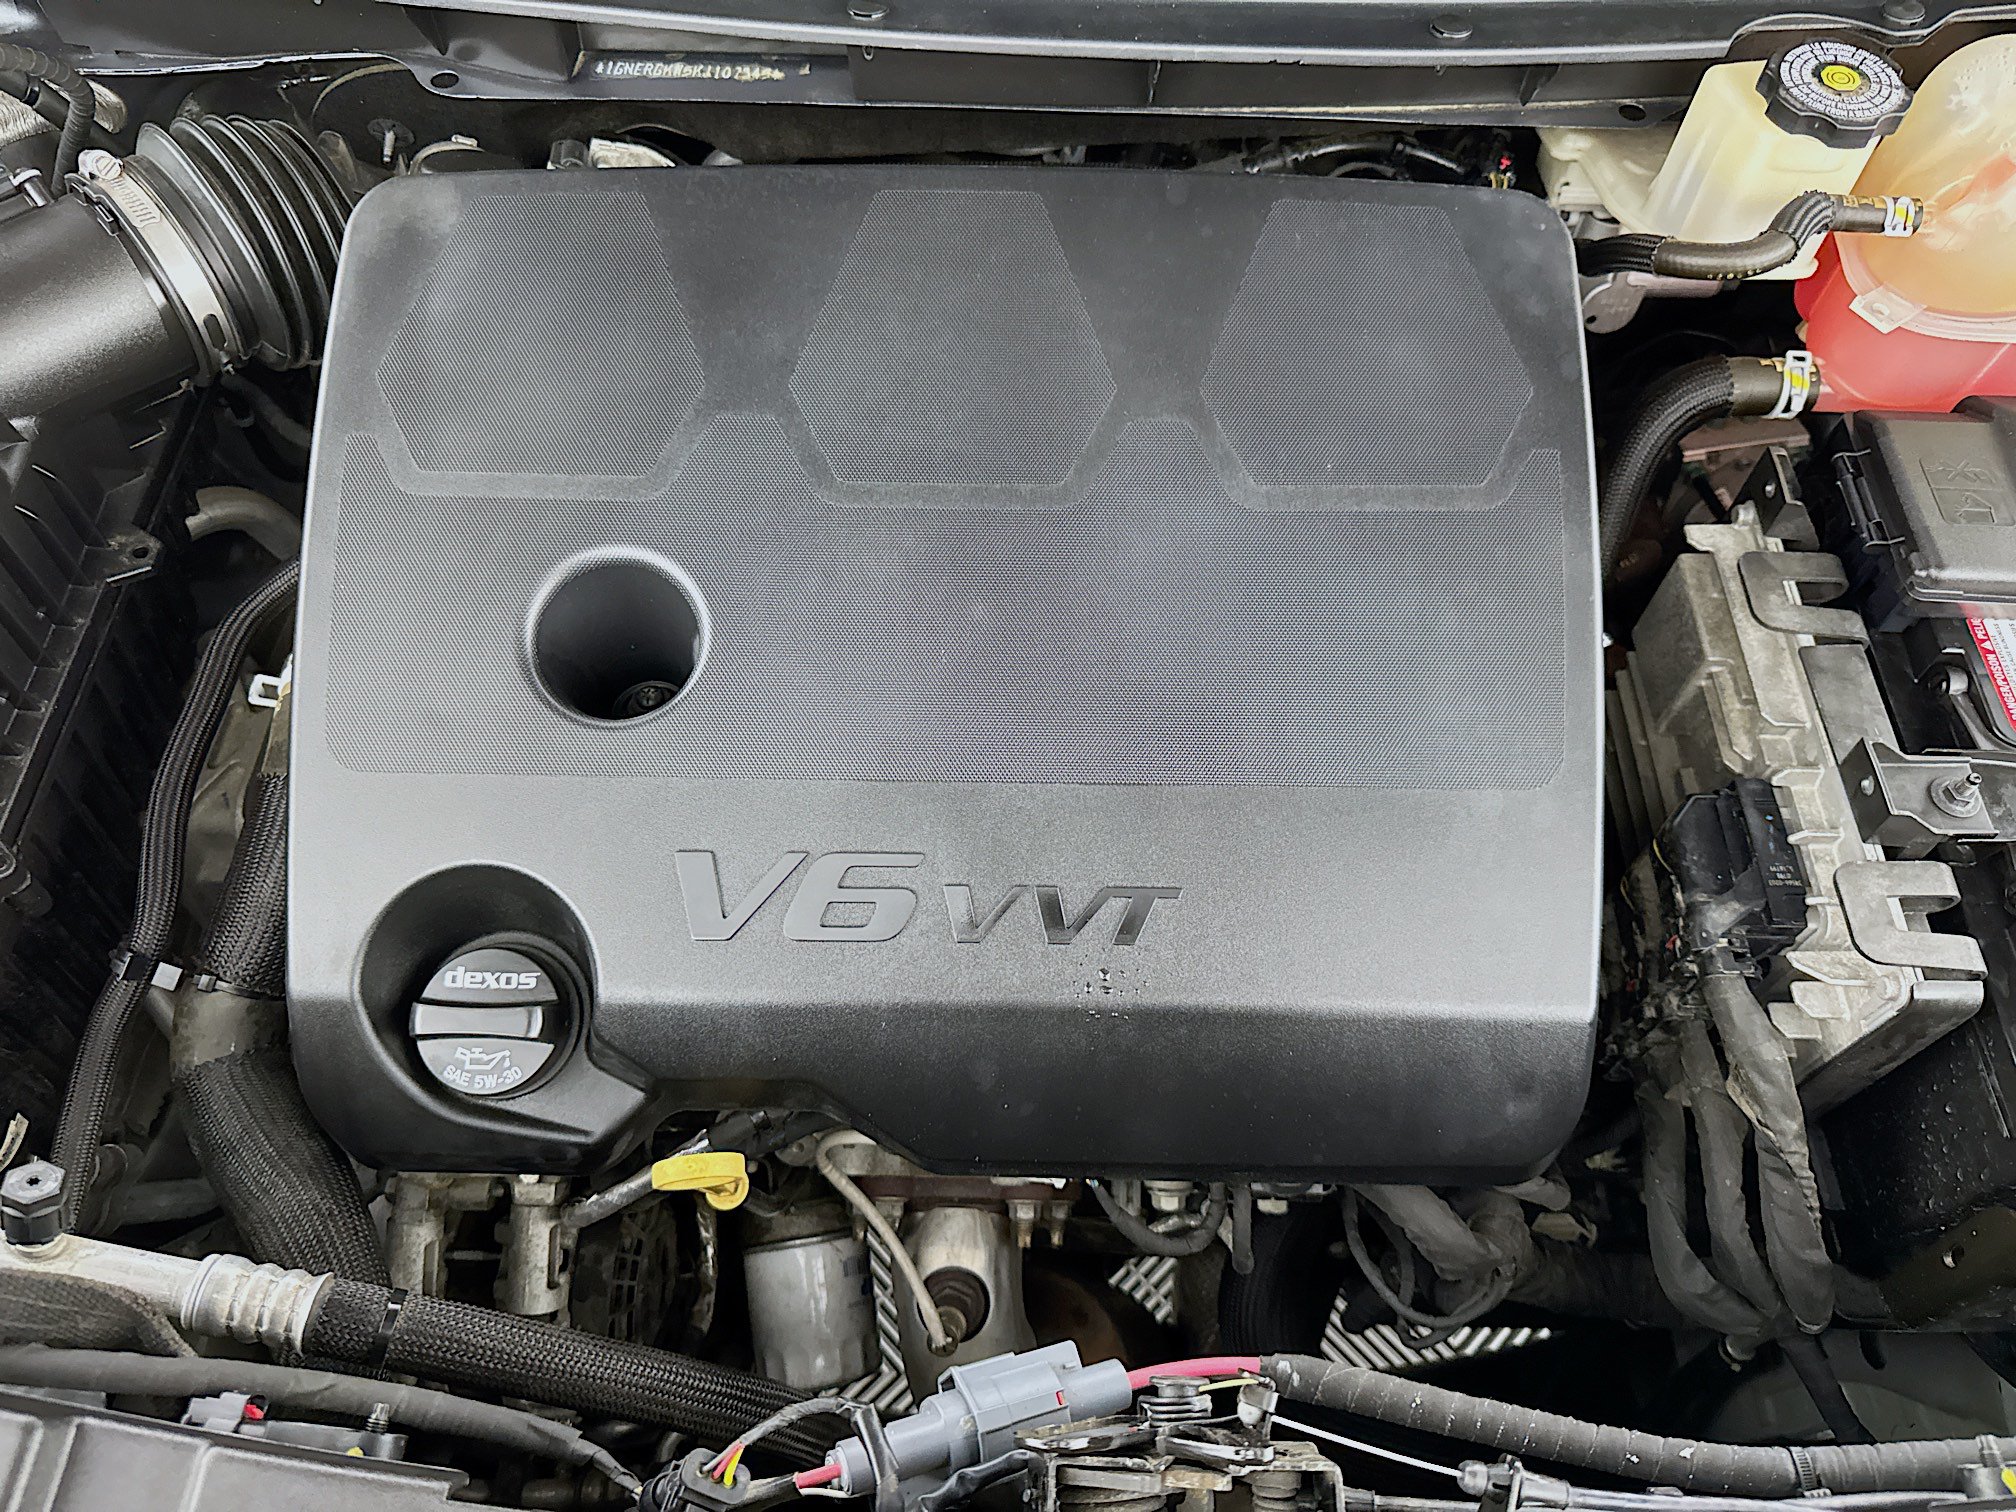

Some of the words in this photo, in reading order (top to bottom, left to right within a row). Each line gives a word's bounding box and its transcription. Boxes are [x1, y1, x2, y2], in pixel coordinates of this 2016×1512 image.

[675, 850, 925, 942] V6
[943, 884, 1183, 946] VVT
[444, 966, 541, 989] dexos
[443, 1065, 472, 1088] SAE
[474, 1066, 523, 1089] 5W-30
